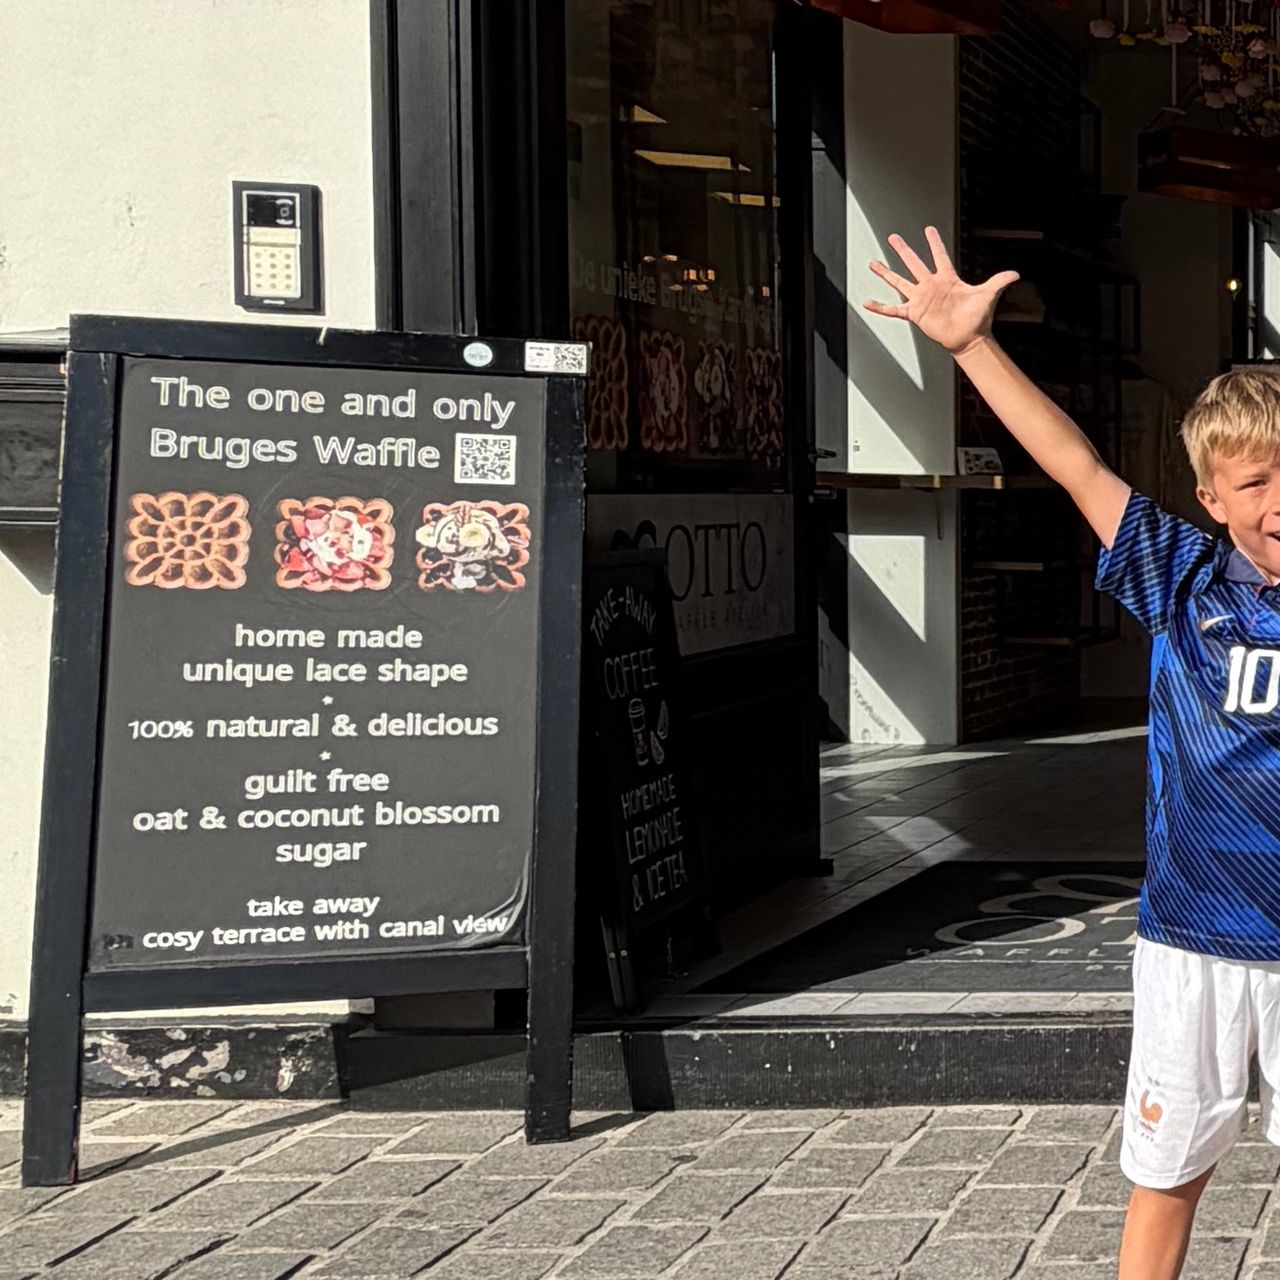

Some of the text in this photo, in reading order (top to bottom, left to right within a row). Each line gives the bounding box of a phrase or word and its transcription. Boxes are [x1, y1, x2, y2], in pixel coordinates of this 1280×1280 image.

[151, 376, 516, 429] The one and only
[150, 428, 440, 469] Bruges Waffle
[665, 522, 766, 602] OTTO
[235, 623, 423, 648] home made
[183, 658, 468, 688] unique lace shape
[604, 648, 659, 700] COFFEE
[128, 713, 499, 740] 100% natural & delicious
[244, 768, 390, 800] guilt free
[132, 801, 500, 831] oat & coconut blossom
[275, 840, 367, 867] sugar
[246, 896, 381, 918] take away
[142, 915, 509, 951] cosy terrace with canal view
